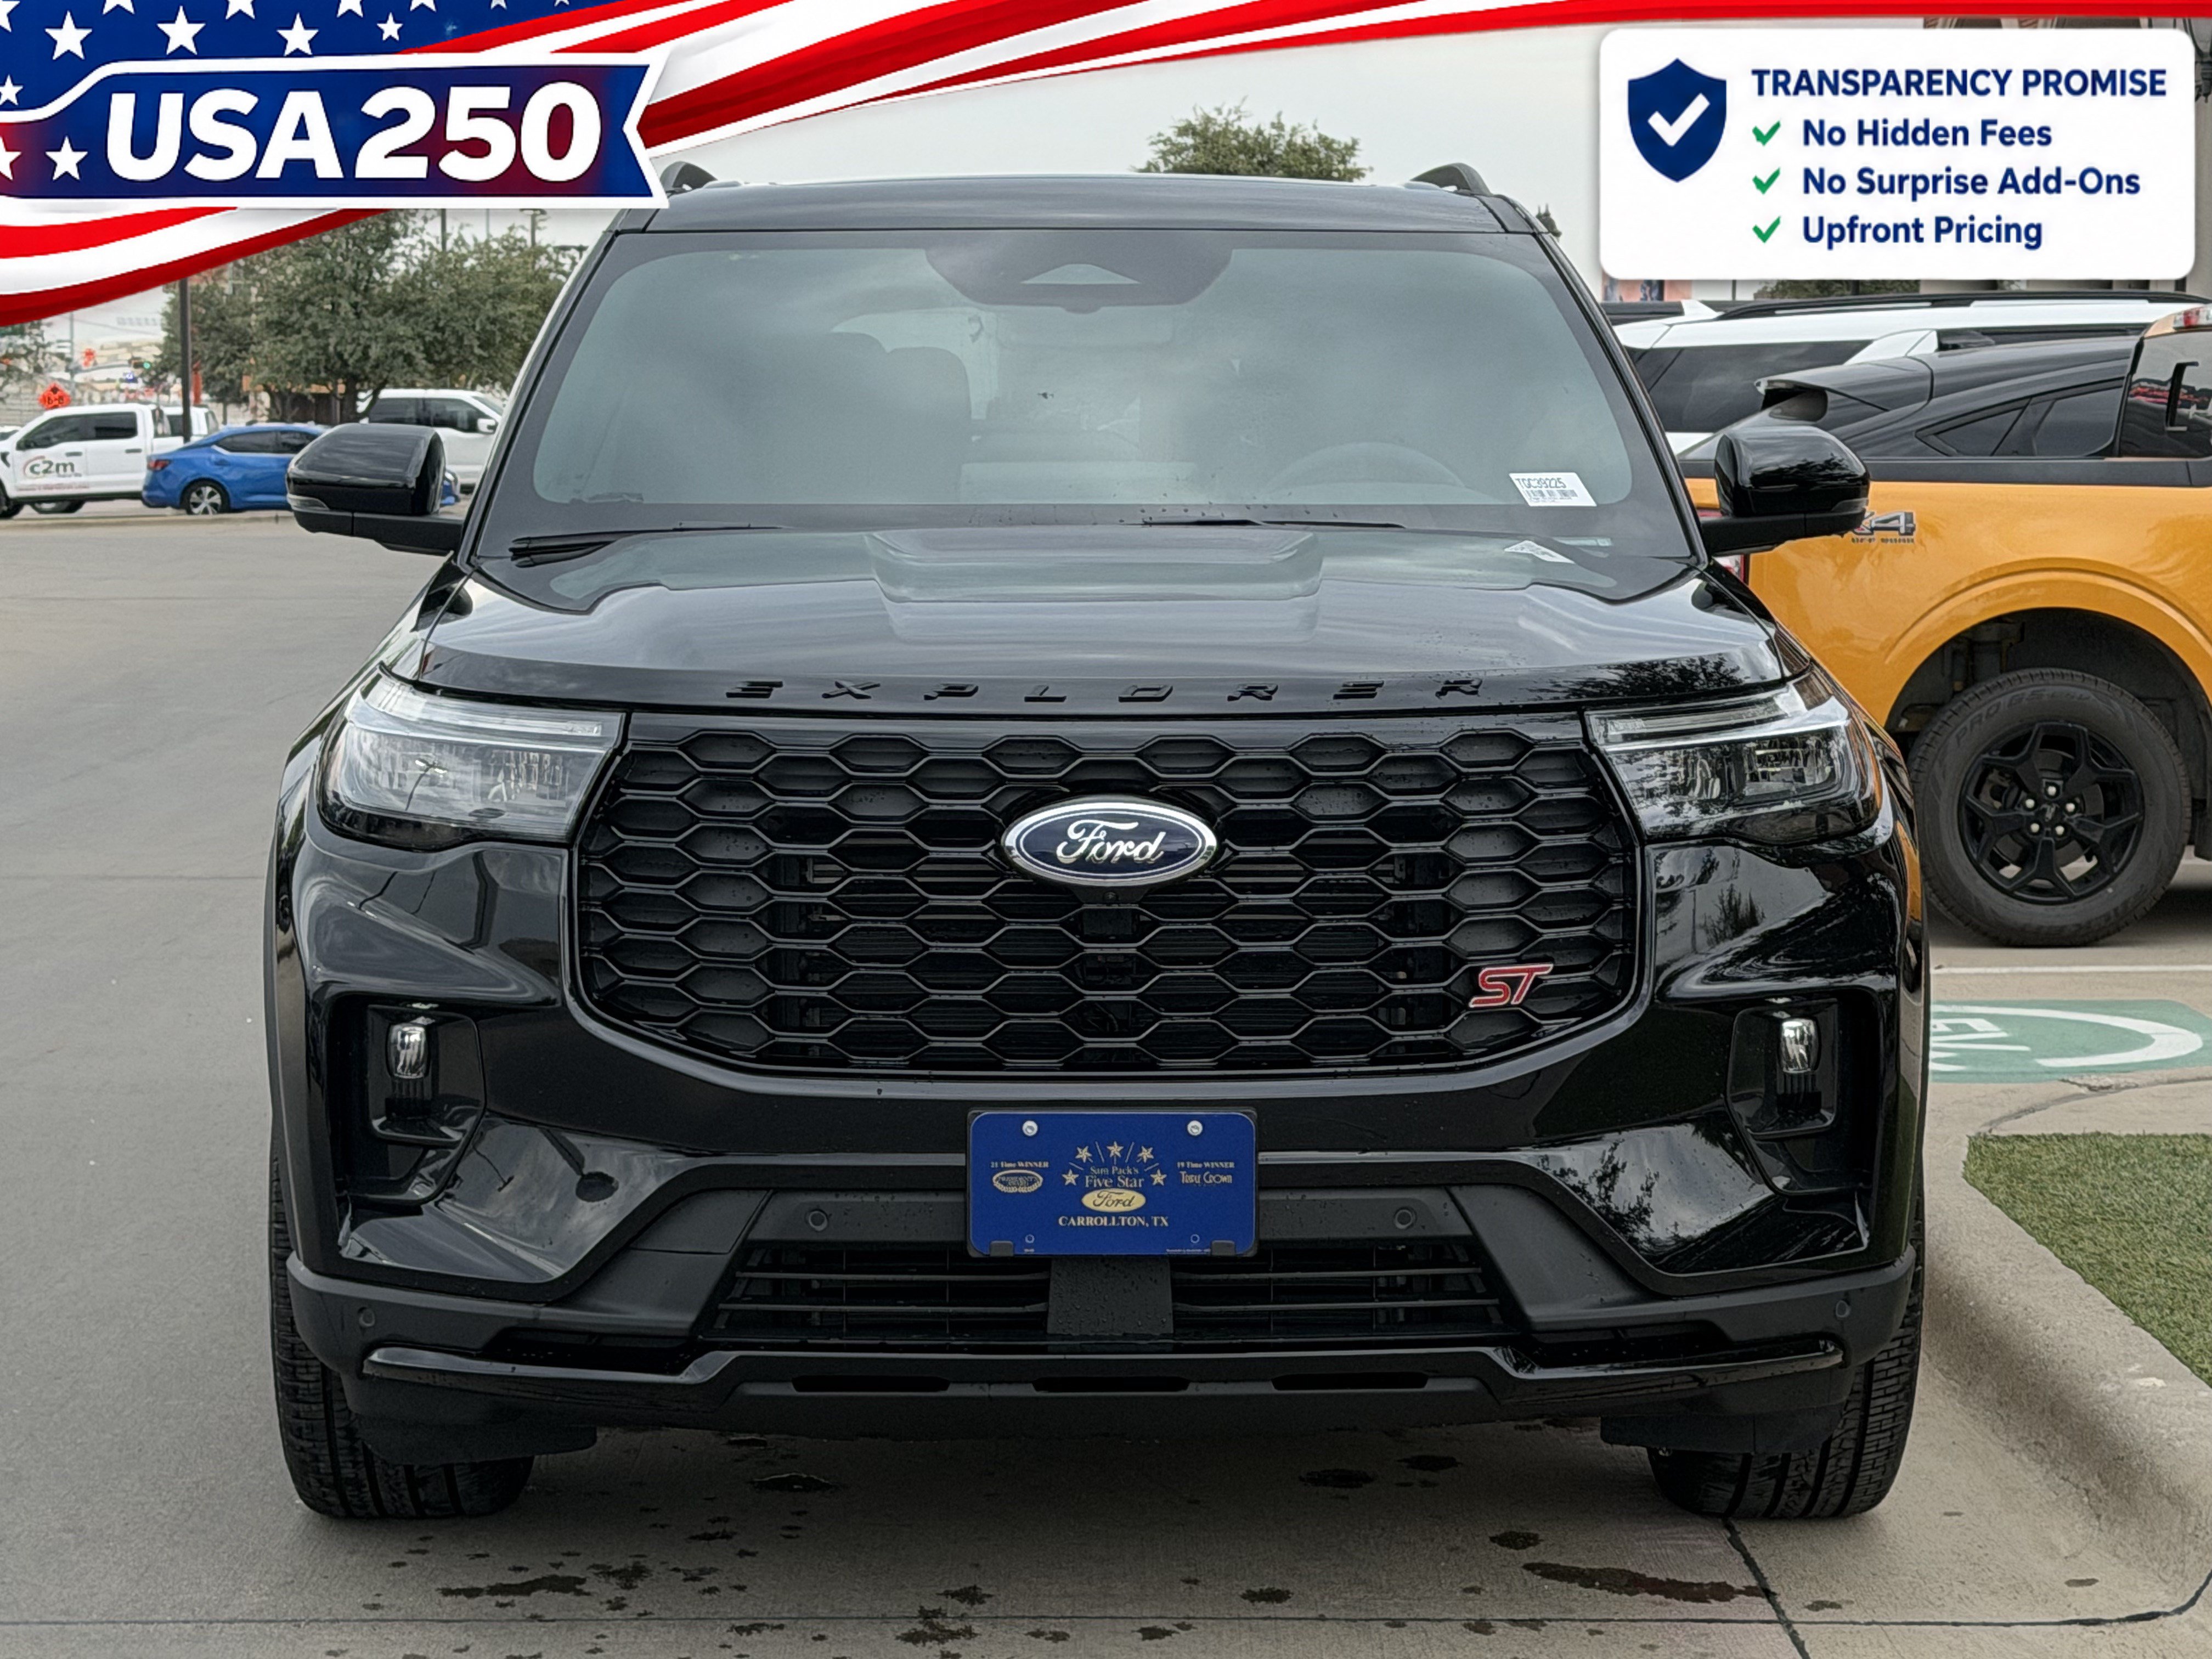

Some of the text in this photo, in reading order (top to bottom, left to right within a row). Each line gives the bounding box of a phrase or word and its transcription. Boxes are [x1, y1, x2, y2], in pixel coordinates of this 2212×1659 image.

[29, 460, 75, 475] c2m
[725, 676, 1483, 702] EXPLORER
[1056, 819, 1166, 865] Ford
[1468, 963, 1554, 1008] ST
[1090, 1165, 1139, 1175] Sam Pack's
[1085, 1175, 1145, 1188] Five Star
[1092, 1190, 1135, 1207] Ford
[1058, 1216, 1169, 1227] CARROLLTON, TX
